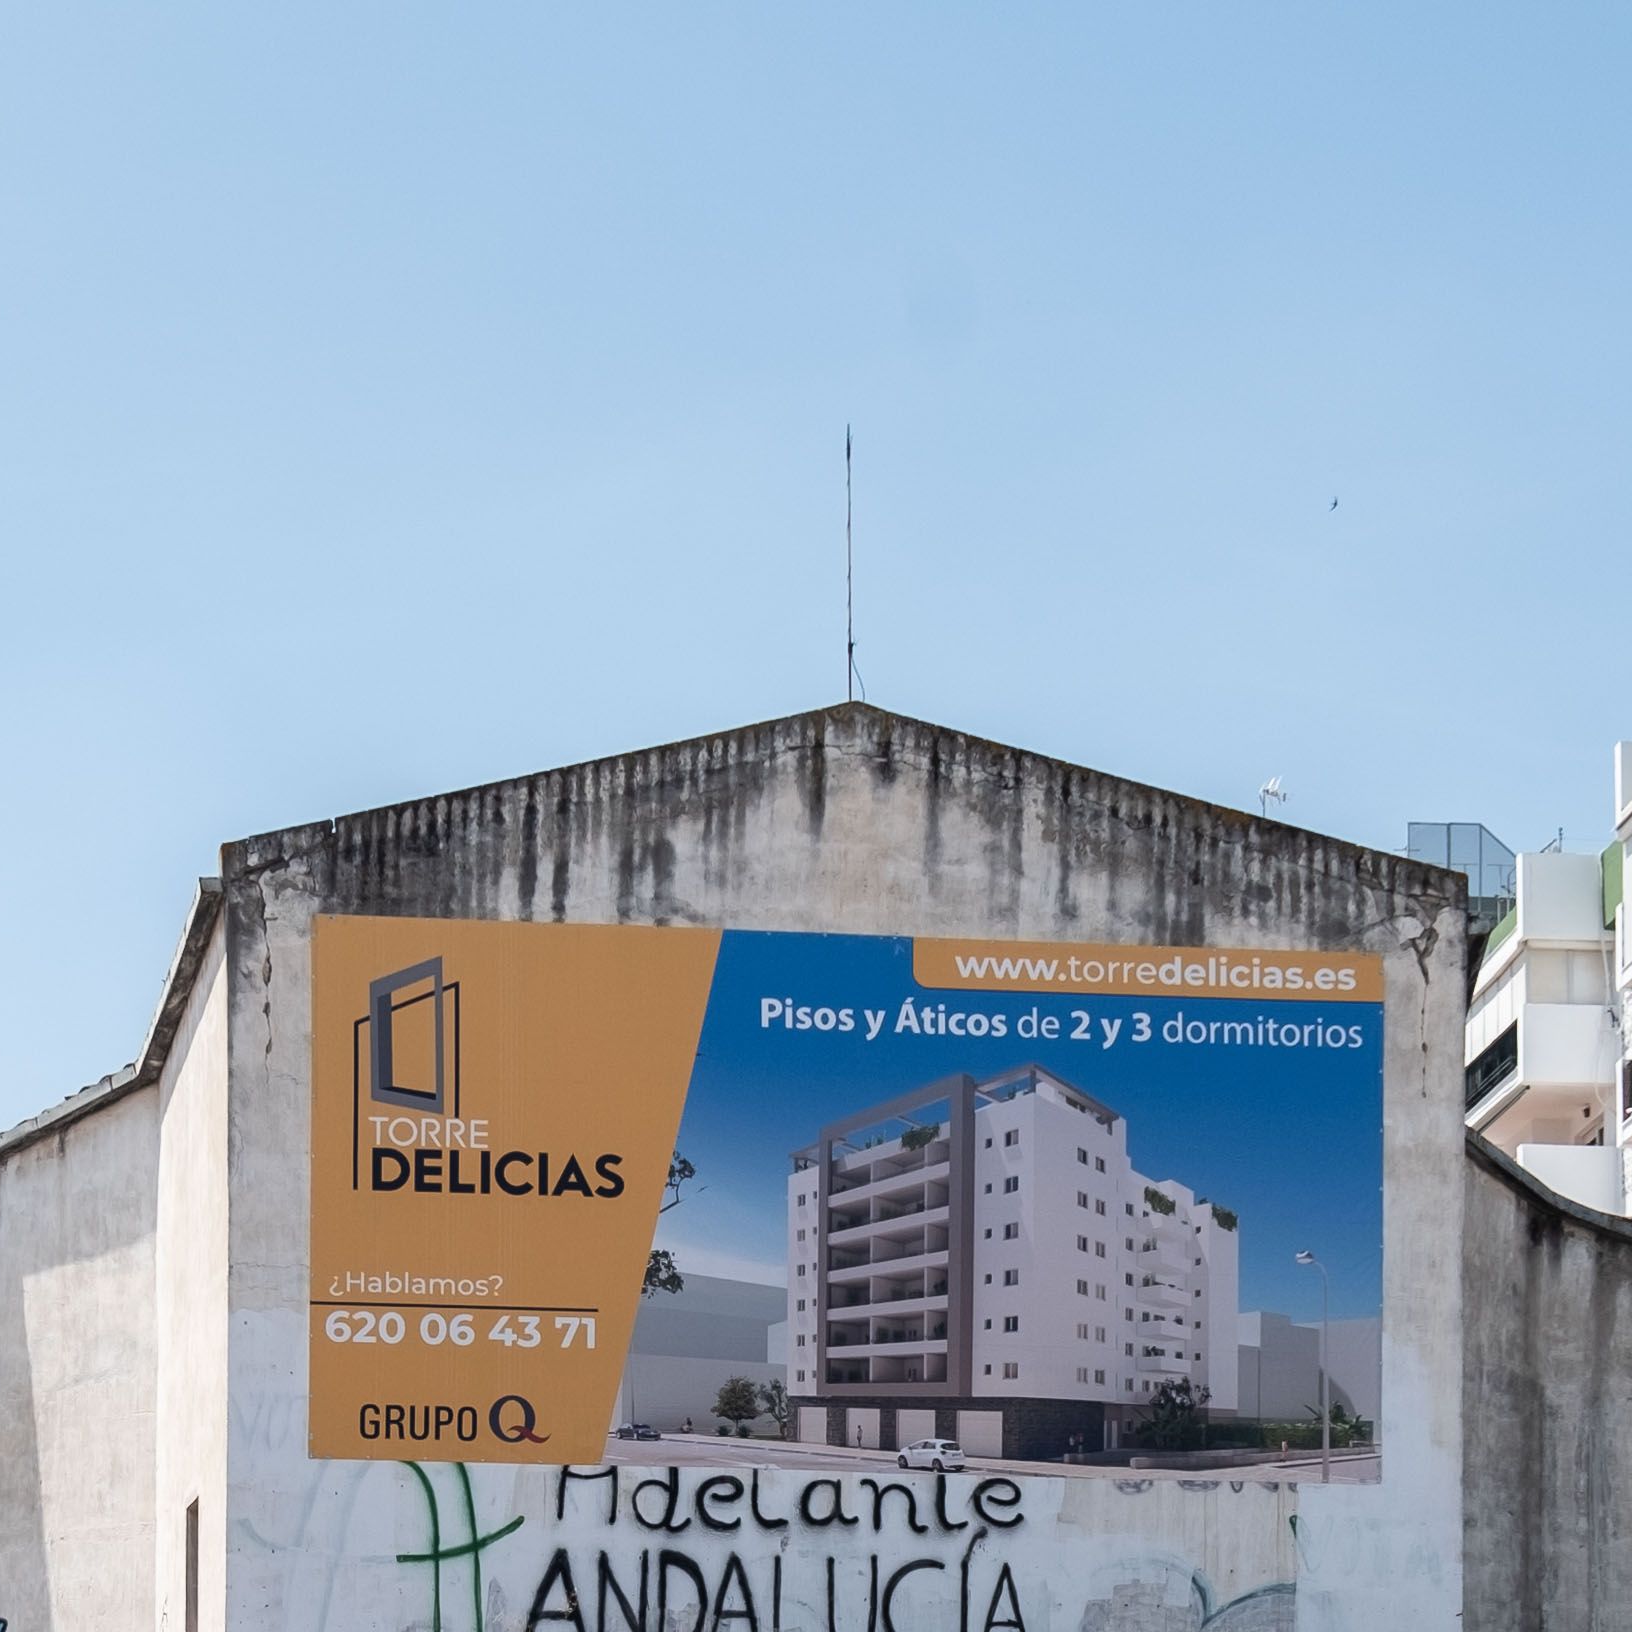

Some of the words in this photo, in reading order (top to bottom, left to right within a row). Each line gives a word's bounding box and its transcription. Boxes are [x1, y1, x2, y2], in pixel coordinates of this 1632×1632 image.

[955, 955, 1357, 991] www.torredelicias.es
[760, 998, 855, 1032] Pisos
[863, 1008, 886, 1042] y
[894, 997, 1008, 1038] Áticos
[1017, 1007, 1060, 1039] de
[1070, 1010, 1092, 1041] 2
[1100, 1017, 1123, 1050] y
[1131, 1012, 1153, 1043] 3
[1163, 1011, 1364, 1049] dormitorios
[368, 1116, 489, 1149] TORRE
[371, 1147, 625, 1199] DELICIAS
[329, 1271, 504, 1297] ¿Hablamos?
[325, 1310, 406, 1345] 620
[419, 1312, 476, 1347] 06
[487, 1314, 542, 1348] 43
[554, 1316, 596, 1350] 71
[359, 1403, 478, 1442] GRUPO
[488, 1394, 552, 1444] Q
